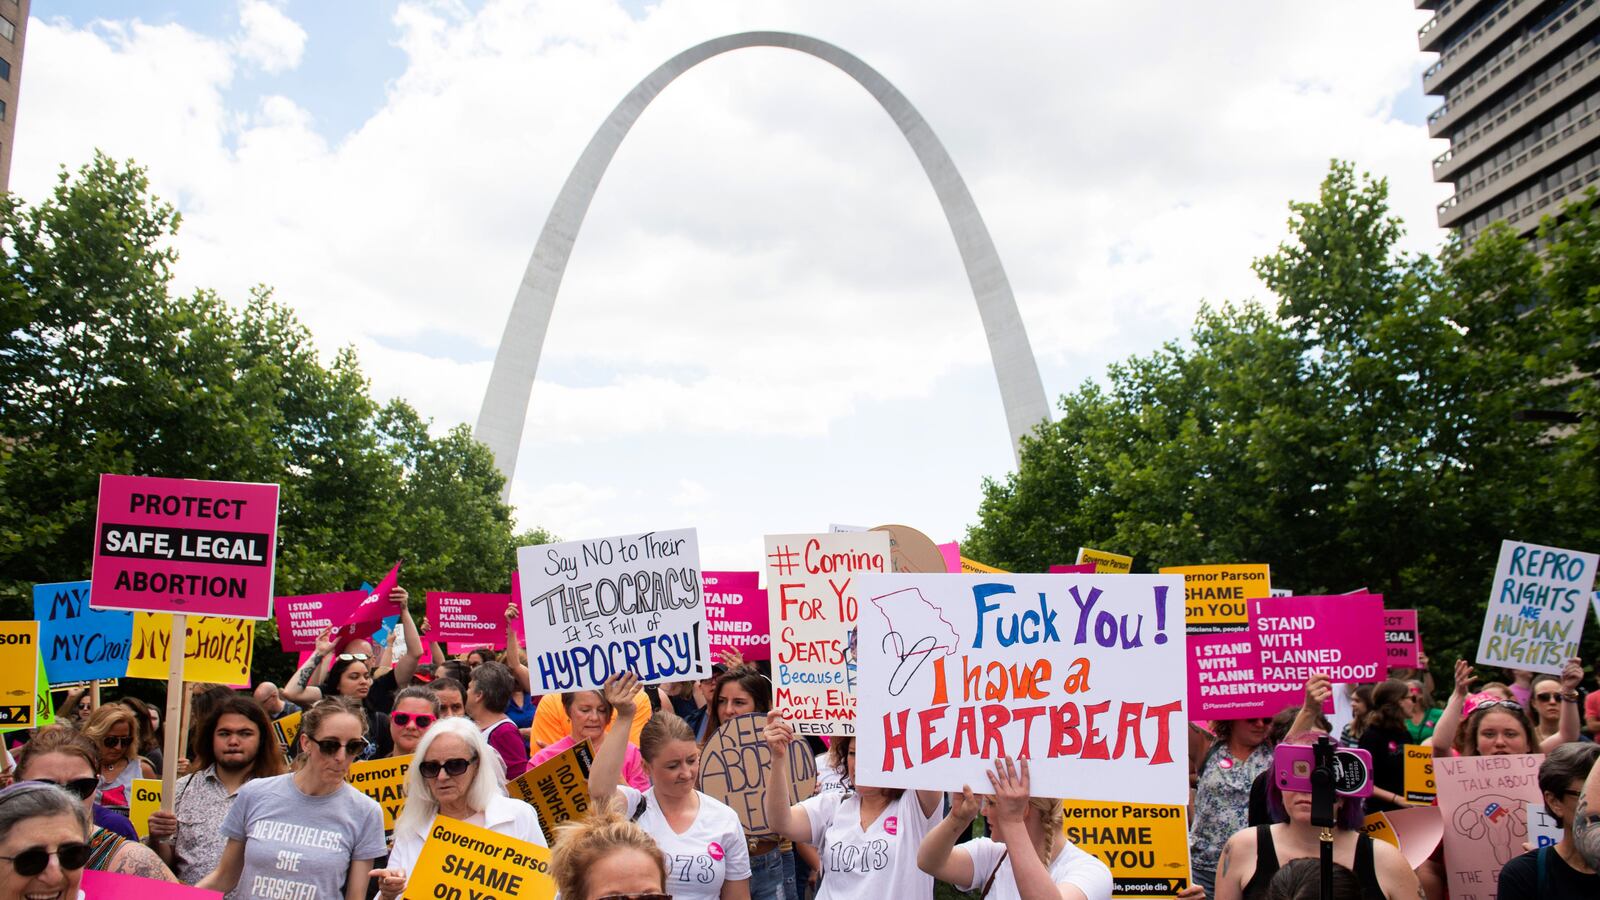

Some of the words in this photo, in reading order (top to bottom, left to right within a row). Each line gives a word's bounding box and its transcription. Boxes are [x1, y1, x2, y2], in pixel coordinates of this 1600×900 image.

[130, 493, 247, 520] PROTECT
[105, 530, 175, 559] SAFE,
[180, 535, 263, 561] LEGAL
[544, 549, 578, 580] Say
[583, 540, 614, 567] NO
[618, 538, 638, 563] to
[638, 531, 686, 559] Their
[1509, 546, 1585, 582] REPRO
[113, 570, 247, 598] ABORTION
[1221, 571, 1265, 580] Parson
[48, 589, 89, 621] MY
[288, 603, 292, 611] I
[293, 601, 322, 611] STAND
[530, 567, 700, 625] THEOCRACY
[1500, 578, 1580, 613] RIGHTS
[290, 611, 312, 619] WITH
[705, 607, 725, 618] TH
[971, 583, 1061, 649] Fuck
[1208, 603, 1246, 616] YOU
[1256, 601, 1261, 614] I
[1519, 605, 1542, 619] ARE
[291, 618, 332, 628] PLANNED
[562, 626, 581, 644] It
[585, 622, 603, 640] Is
[609, 617, 636, 635] Full
[647, 611, 662, 631] of
[1257, 616, 1315, 631] STAND
[1493, 613, 1574, 641] HUMAN
[51, 634, 84, 661] MY
[134, 627, 171, 662] MY
[778, 626, 844, 665] SEATS
[1195, 646, 1201, 656] I
[1204, 643, 1252, 656] STAND
[1258, 633, 1303, 647] WITH
[537, 621, 703, 690] HYPOCRISY!
[1260, 650, 1342, 663] PLANNED
[1486, 635, 1578, 668] RIGHTS!!
[779, 664, 844, 685] Because
[1198, 657, 1237, 670] WITH
[931, 655, 948, 706] I
[962, 655, 1051, 702] have
[1063, 657, 1091, 694] a
[1200, 682, 1303, 697] PARENTHOOD
[776, 688, 819, 710] Mary
[782, 708, 857, 720] COLEMAN
[719, 714, 769, 749] KEE
[842, 724, 855, 734] TO
[882, 700, 1182, 772] HEARTBEAT
[702, 740, 815, 793] ABORION
[1441, 760, 1466, 775] WE
[1476, 758, 1511, 771] NEED
[1517, 757, 1536, 768] TO
[555, 764, 578, 795] YOU
[1458, 779, 1494, 791] TALK
[1498, 774, 1536, 789] ABOUT
[537, 774, 570, 823] SHAME
[1122, 805, 1180, 818] Parson
[1067, 827, 1152, 845] SHAME
[433, 825, 503, 858] Governor
[502, 847, 549, 874] Parso
[1104, 851, 1155, 868] YOU
[276, 850, 303, 872] SHE
[442, 854, 523, 896] SHAME
[1456, 871, 1483, 884] THE
[251, 875, 317, 900] PERSISTED
[1125, 883, 1153, 892] people
[1155, 883, 1168, 891] die
